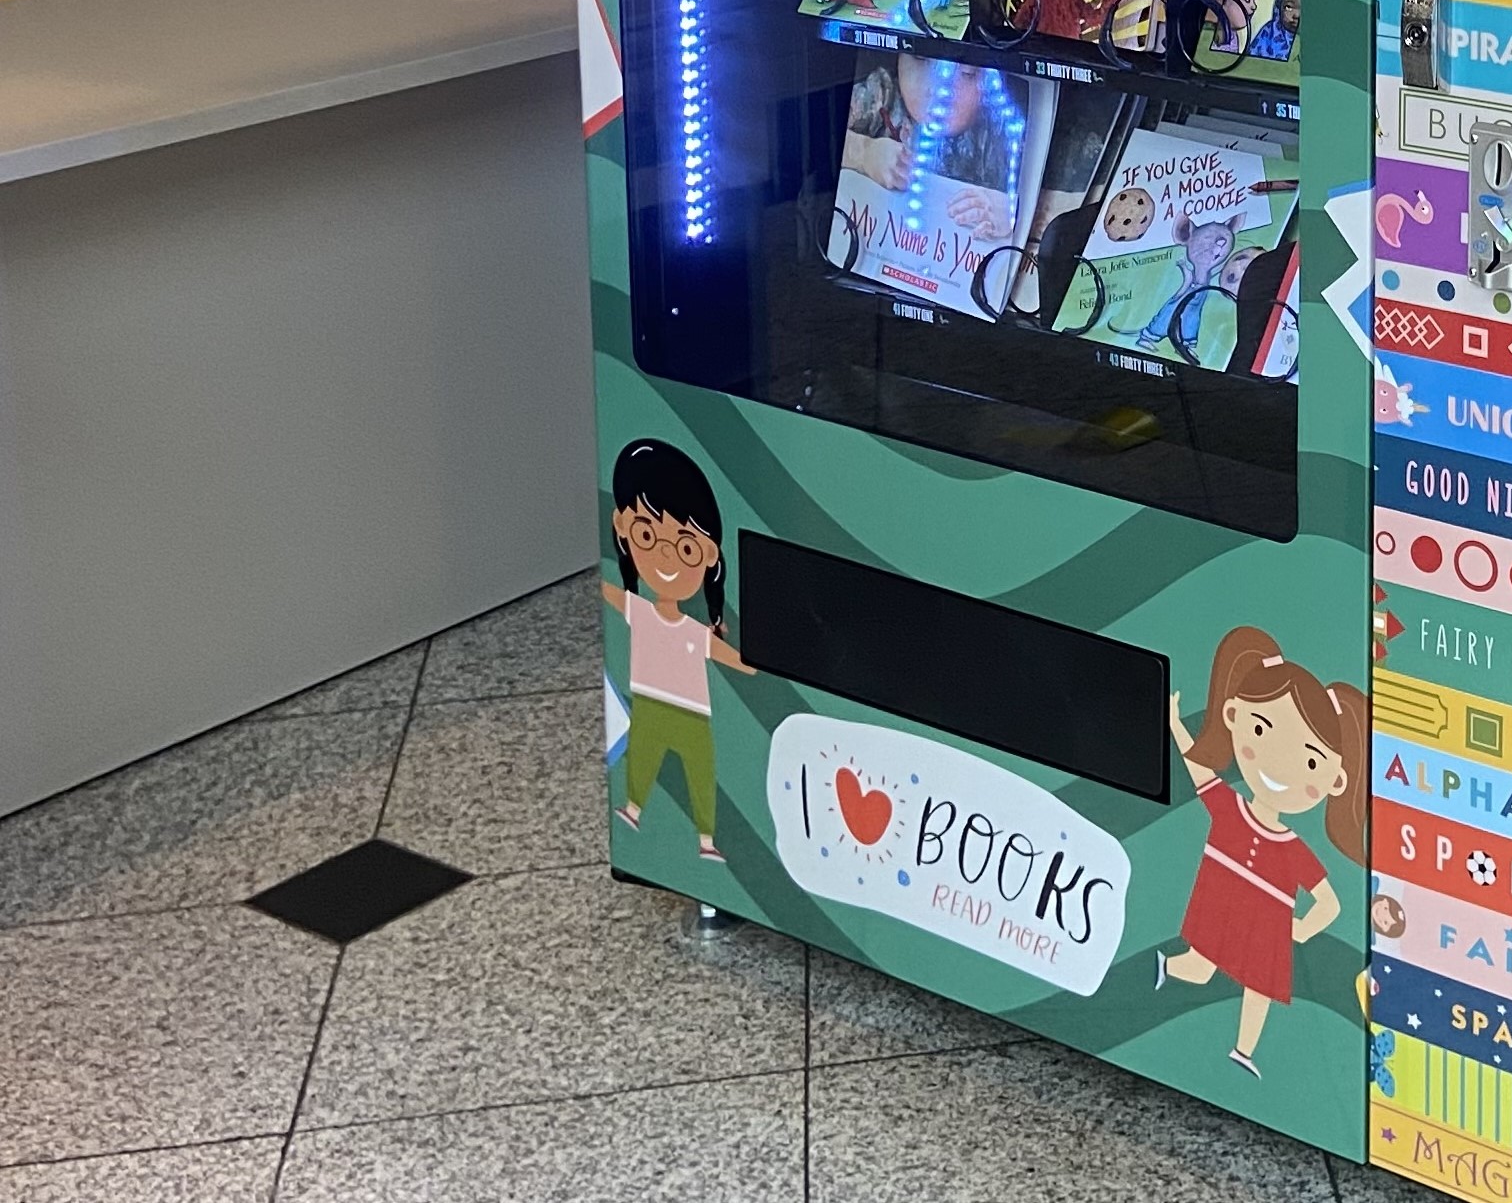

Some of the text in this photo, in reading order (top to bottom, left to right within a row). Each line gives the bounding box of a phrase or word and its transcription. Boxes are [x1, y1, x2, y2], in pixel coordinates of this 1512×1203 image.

[1047, 62, 1070, 79] THIRTY
[1122, 150, 1223, 188] IF YOU GIVE
[1160, 168, 1239, 203] A MOUSE
[1163, 186, 1248, 221] A COOKIE
[843, 198, 946, 263] My Name Is
[1131, 250, 1172, 267] Numeroff
[888, 267, 938, 294] SCHOLASTIC
[1120, 353, 1164, 378] FORTY THREE
[1405, 460, 1470, 506] GOOD
[1420, 618, 1495, 669] FAIRY
[800, 763, 1113, 946] I BOOKS
[932, 882, 1065, 967] READ MORE
